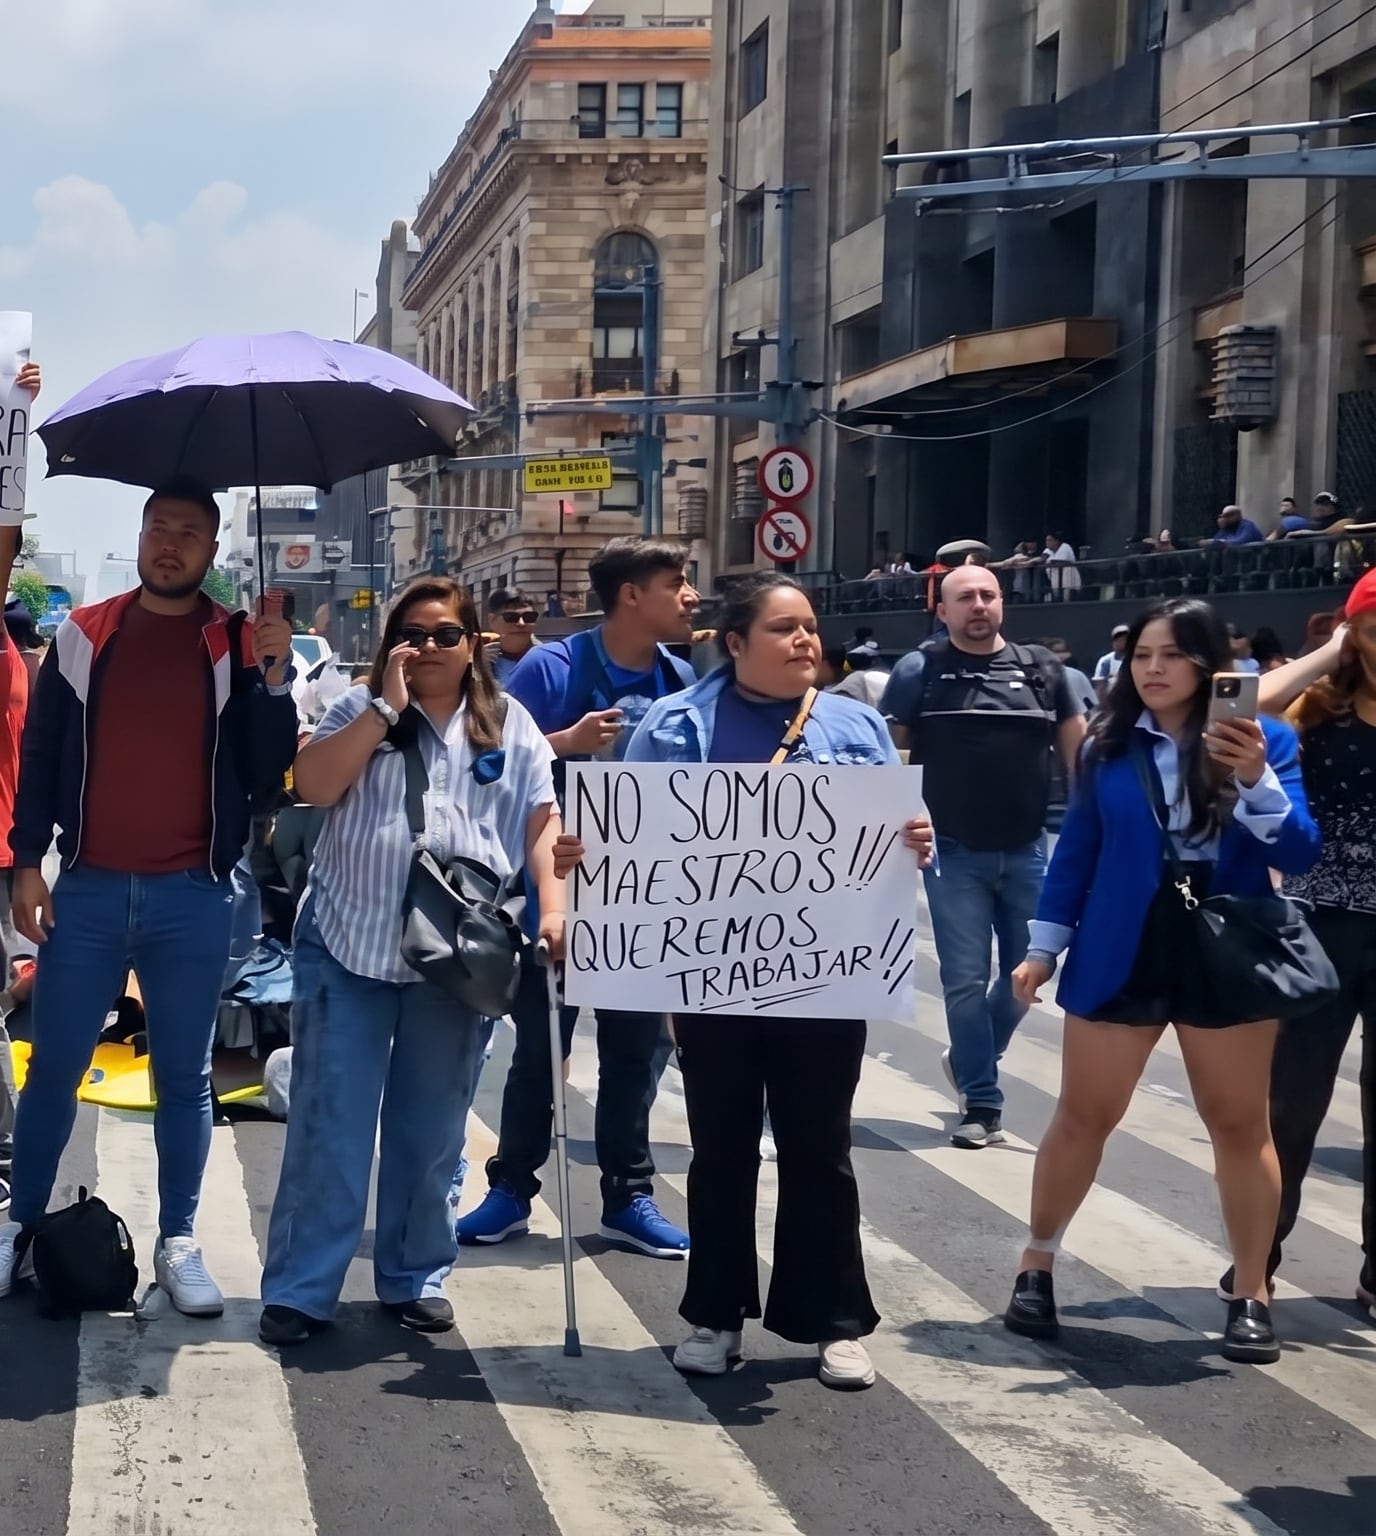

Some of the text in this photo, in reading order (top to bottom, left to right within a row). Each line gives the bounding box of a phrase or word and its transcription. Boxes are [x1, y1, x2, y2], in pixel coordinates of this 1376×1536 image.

[576, 769, 837, 845] NO SOMOS
[571, 906, 818, 972] QUEREMOS
